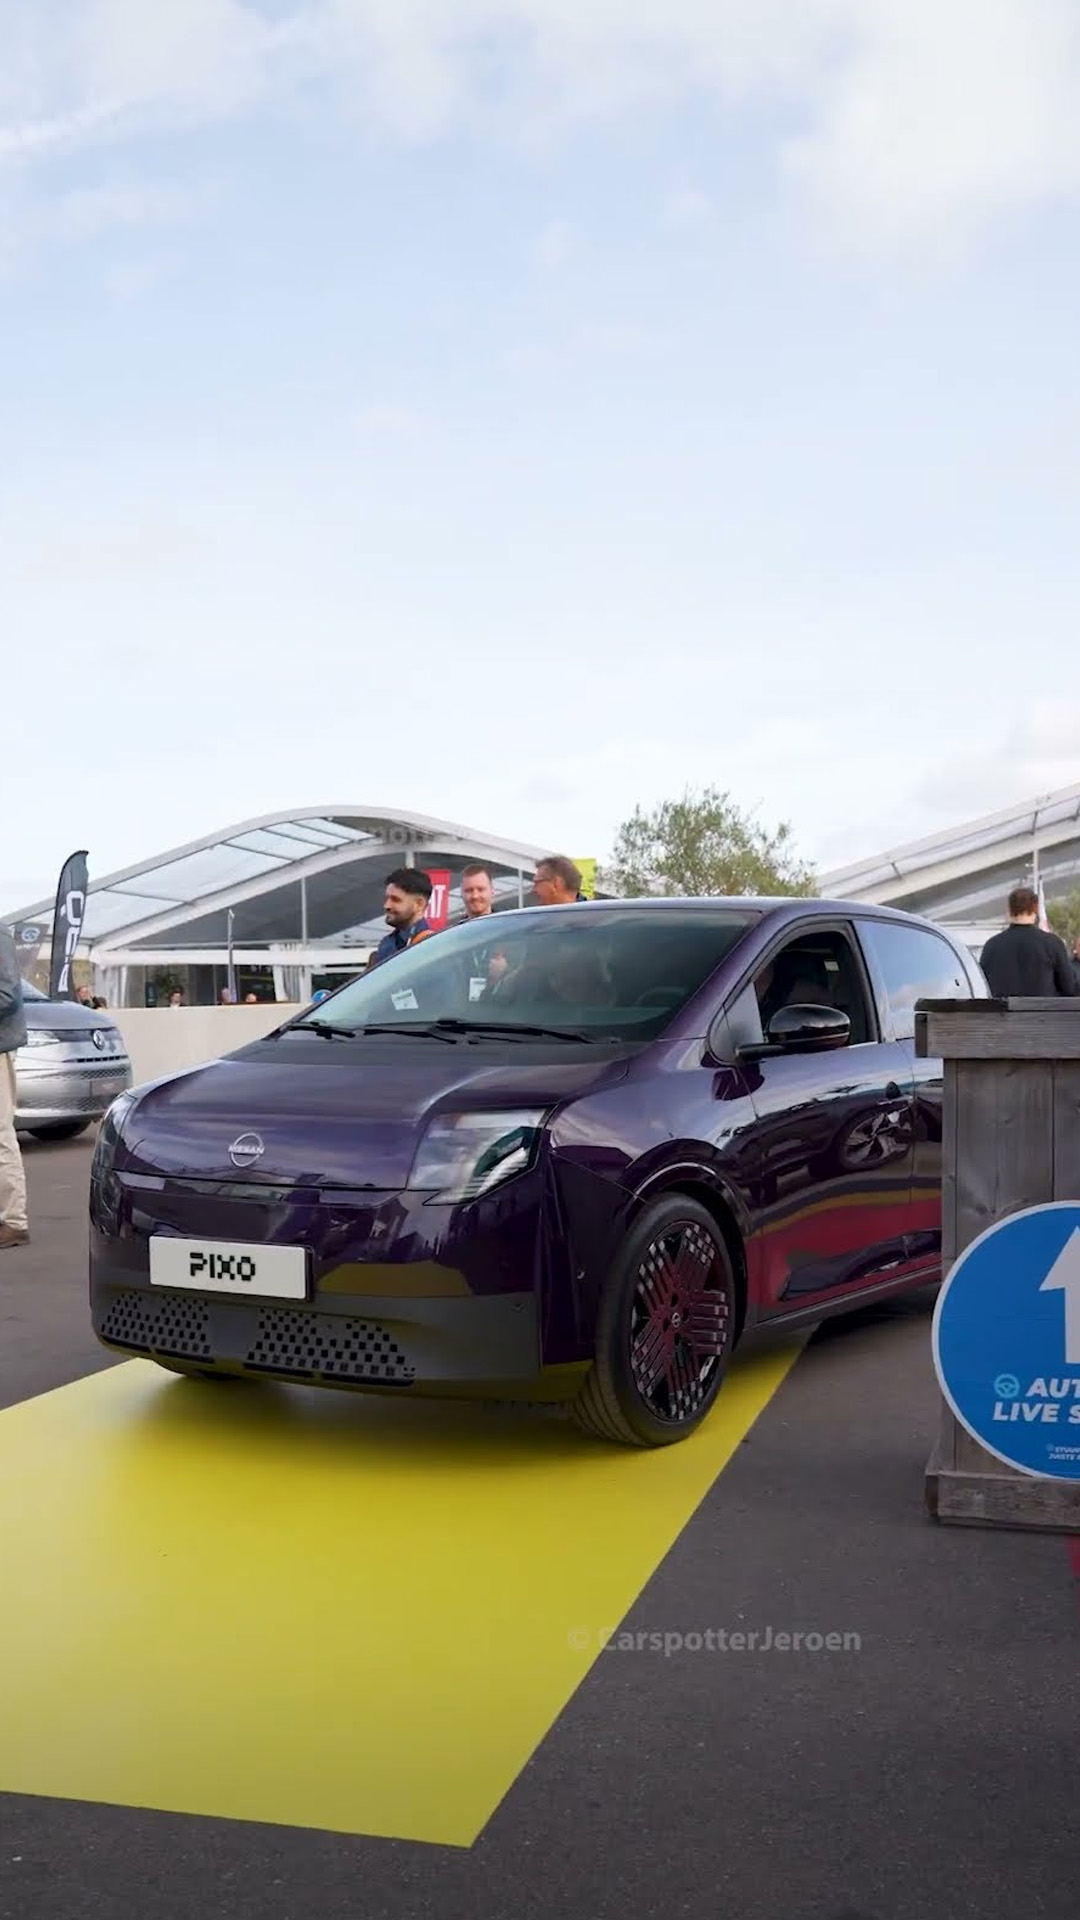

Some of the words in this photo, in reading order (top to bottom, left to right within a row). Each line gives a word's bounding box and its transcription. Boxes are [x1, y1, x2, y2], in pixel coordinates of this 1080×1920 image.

[228, 1145, 265, 1154] NISSAN
[189, 1251, 257, 1282] PIXO
[993, 1402, 1060, 1422] LIVE
